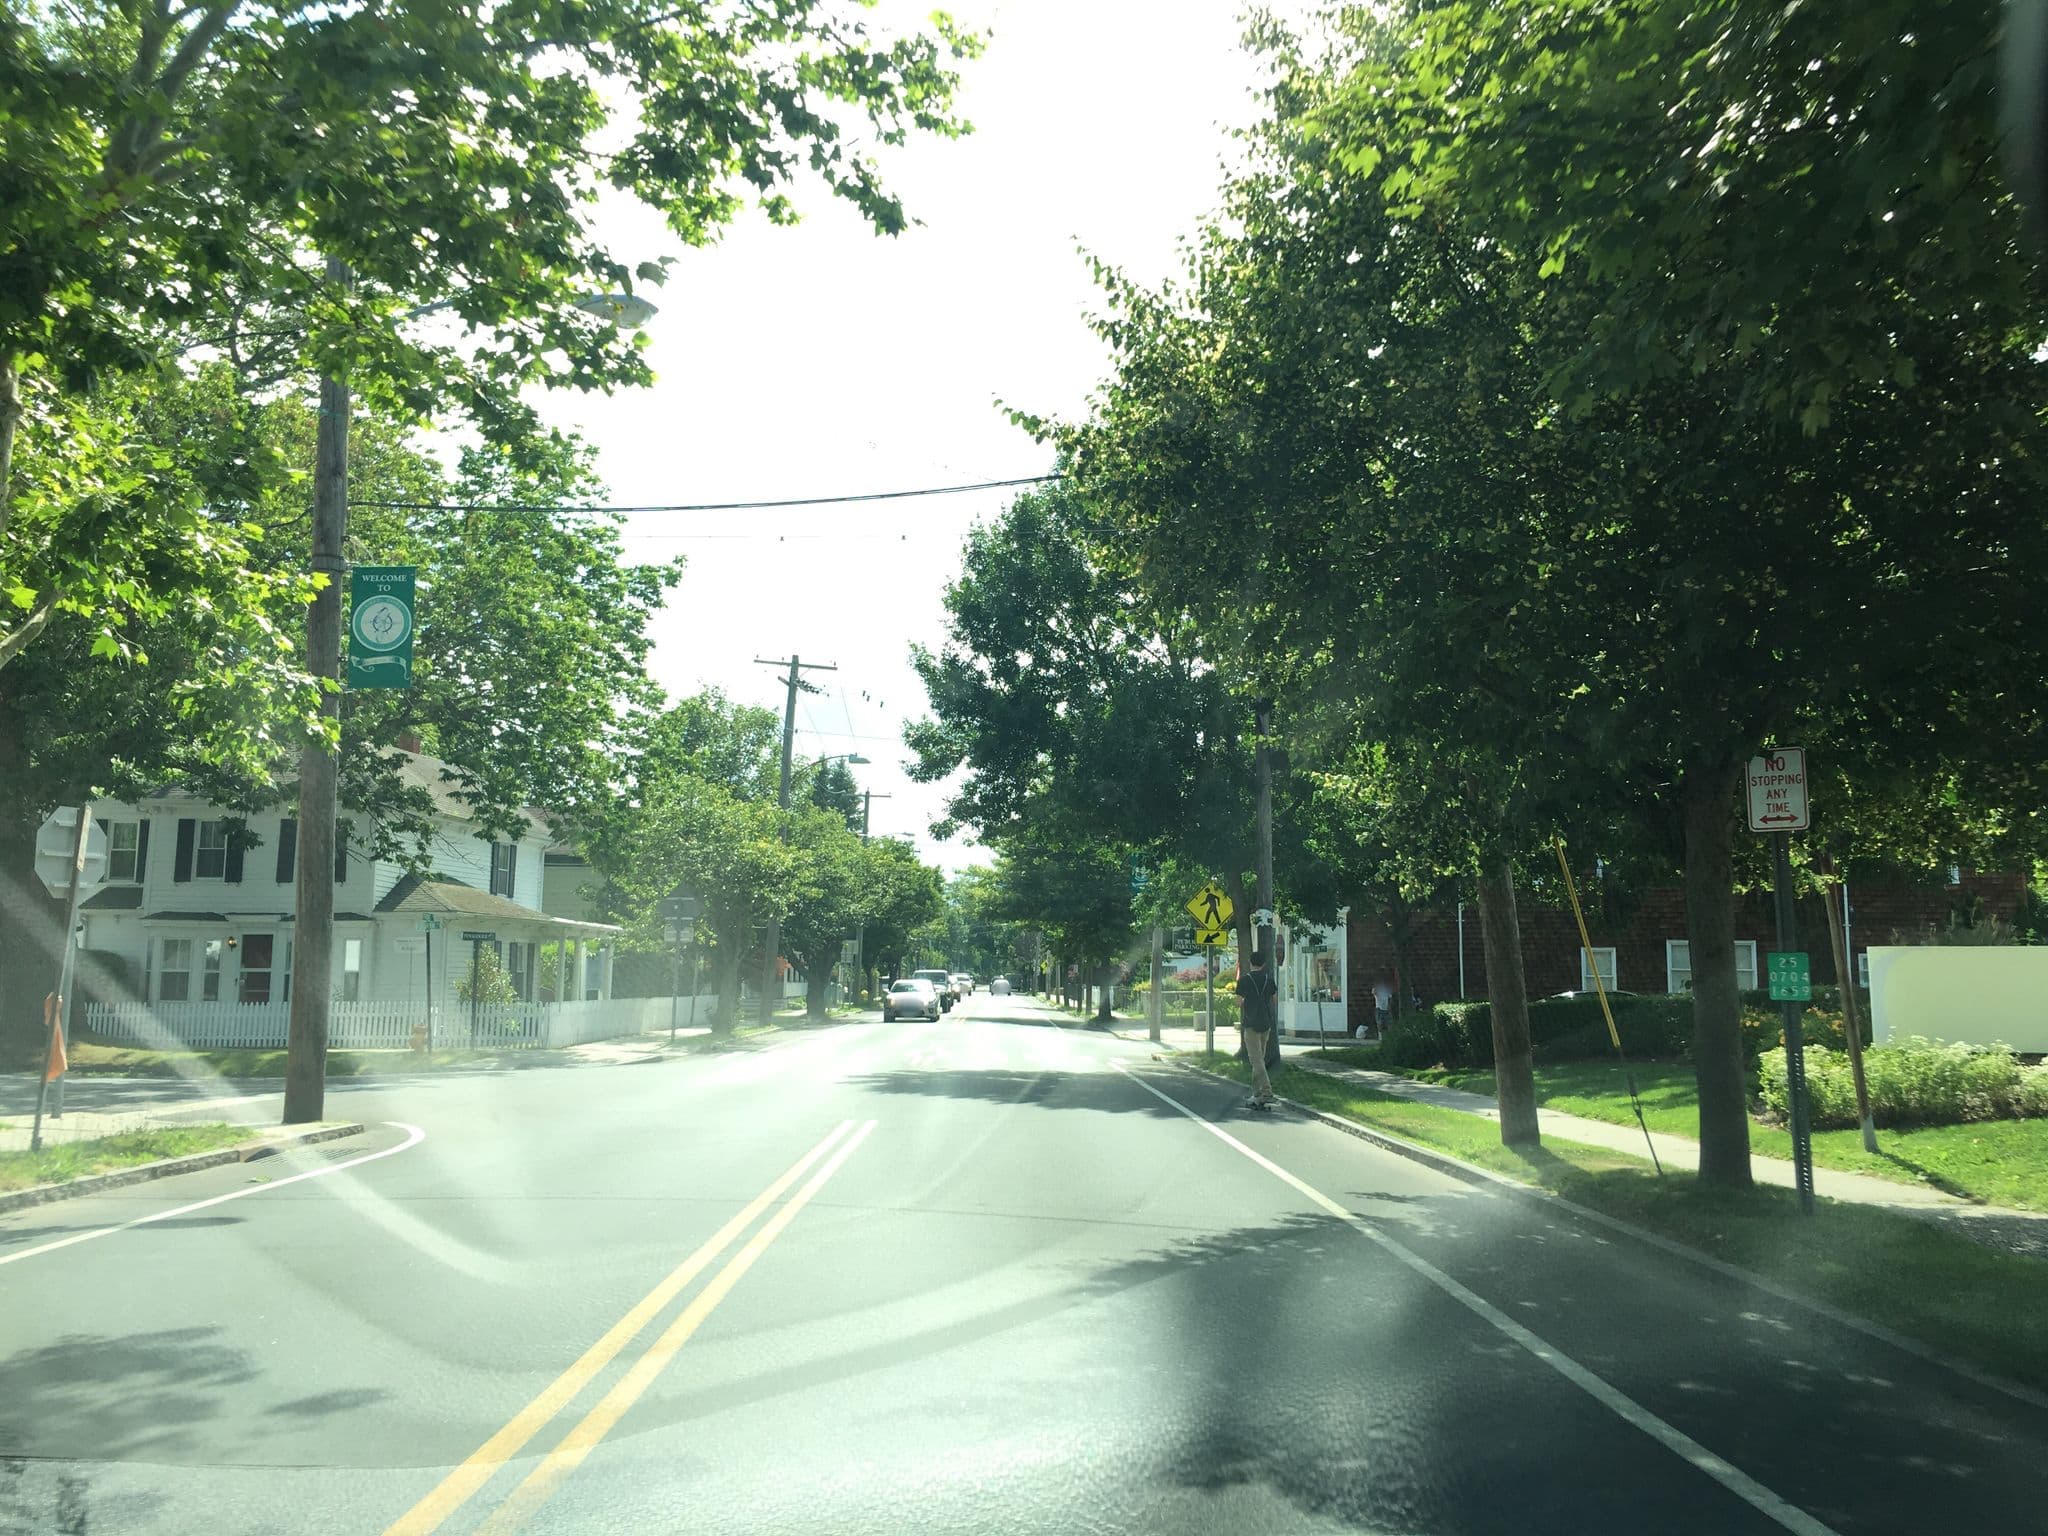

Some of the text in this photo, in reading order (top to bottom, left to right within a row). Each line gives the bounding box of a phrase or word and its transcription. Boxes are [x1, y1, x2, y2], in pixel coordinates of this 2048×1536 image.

[361, 574, 408, 582] WELCOME
[377, 584, 391, 592] TO
[1765, 756, 1785, 772] NO
[1751, 773, 1802, 787] STOPPING
[1766, 788, 1787, 800] ANY
[1766, 802, 1790, 813] TIME
[1778, 957, 1797, 968] 25
[1770, 971, 1809, 982] 0704
